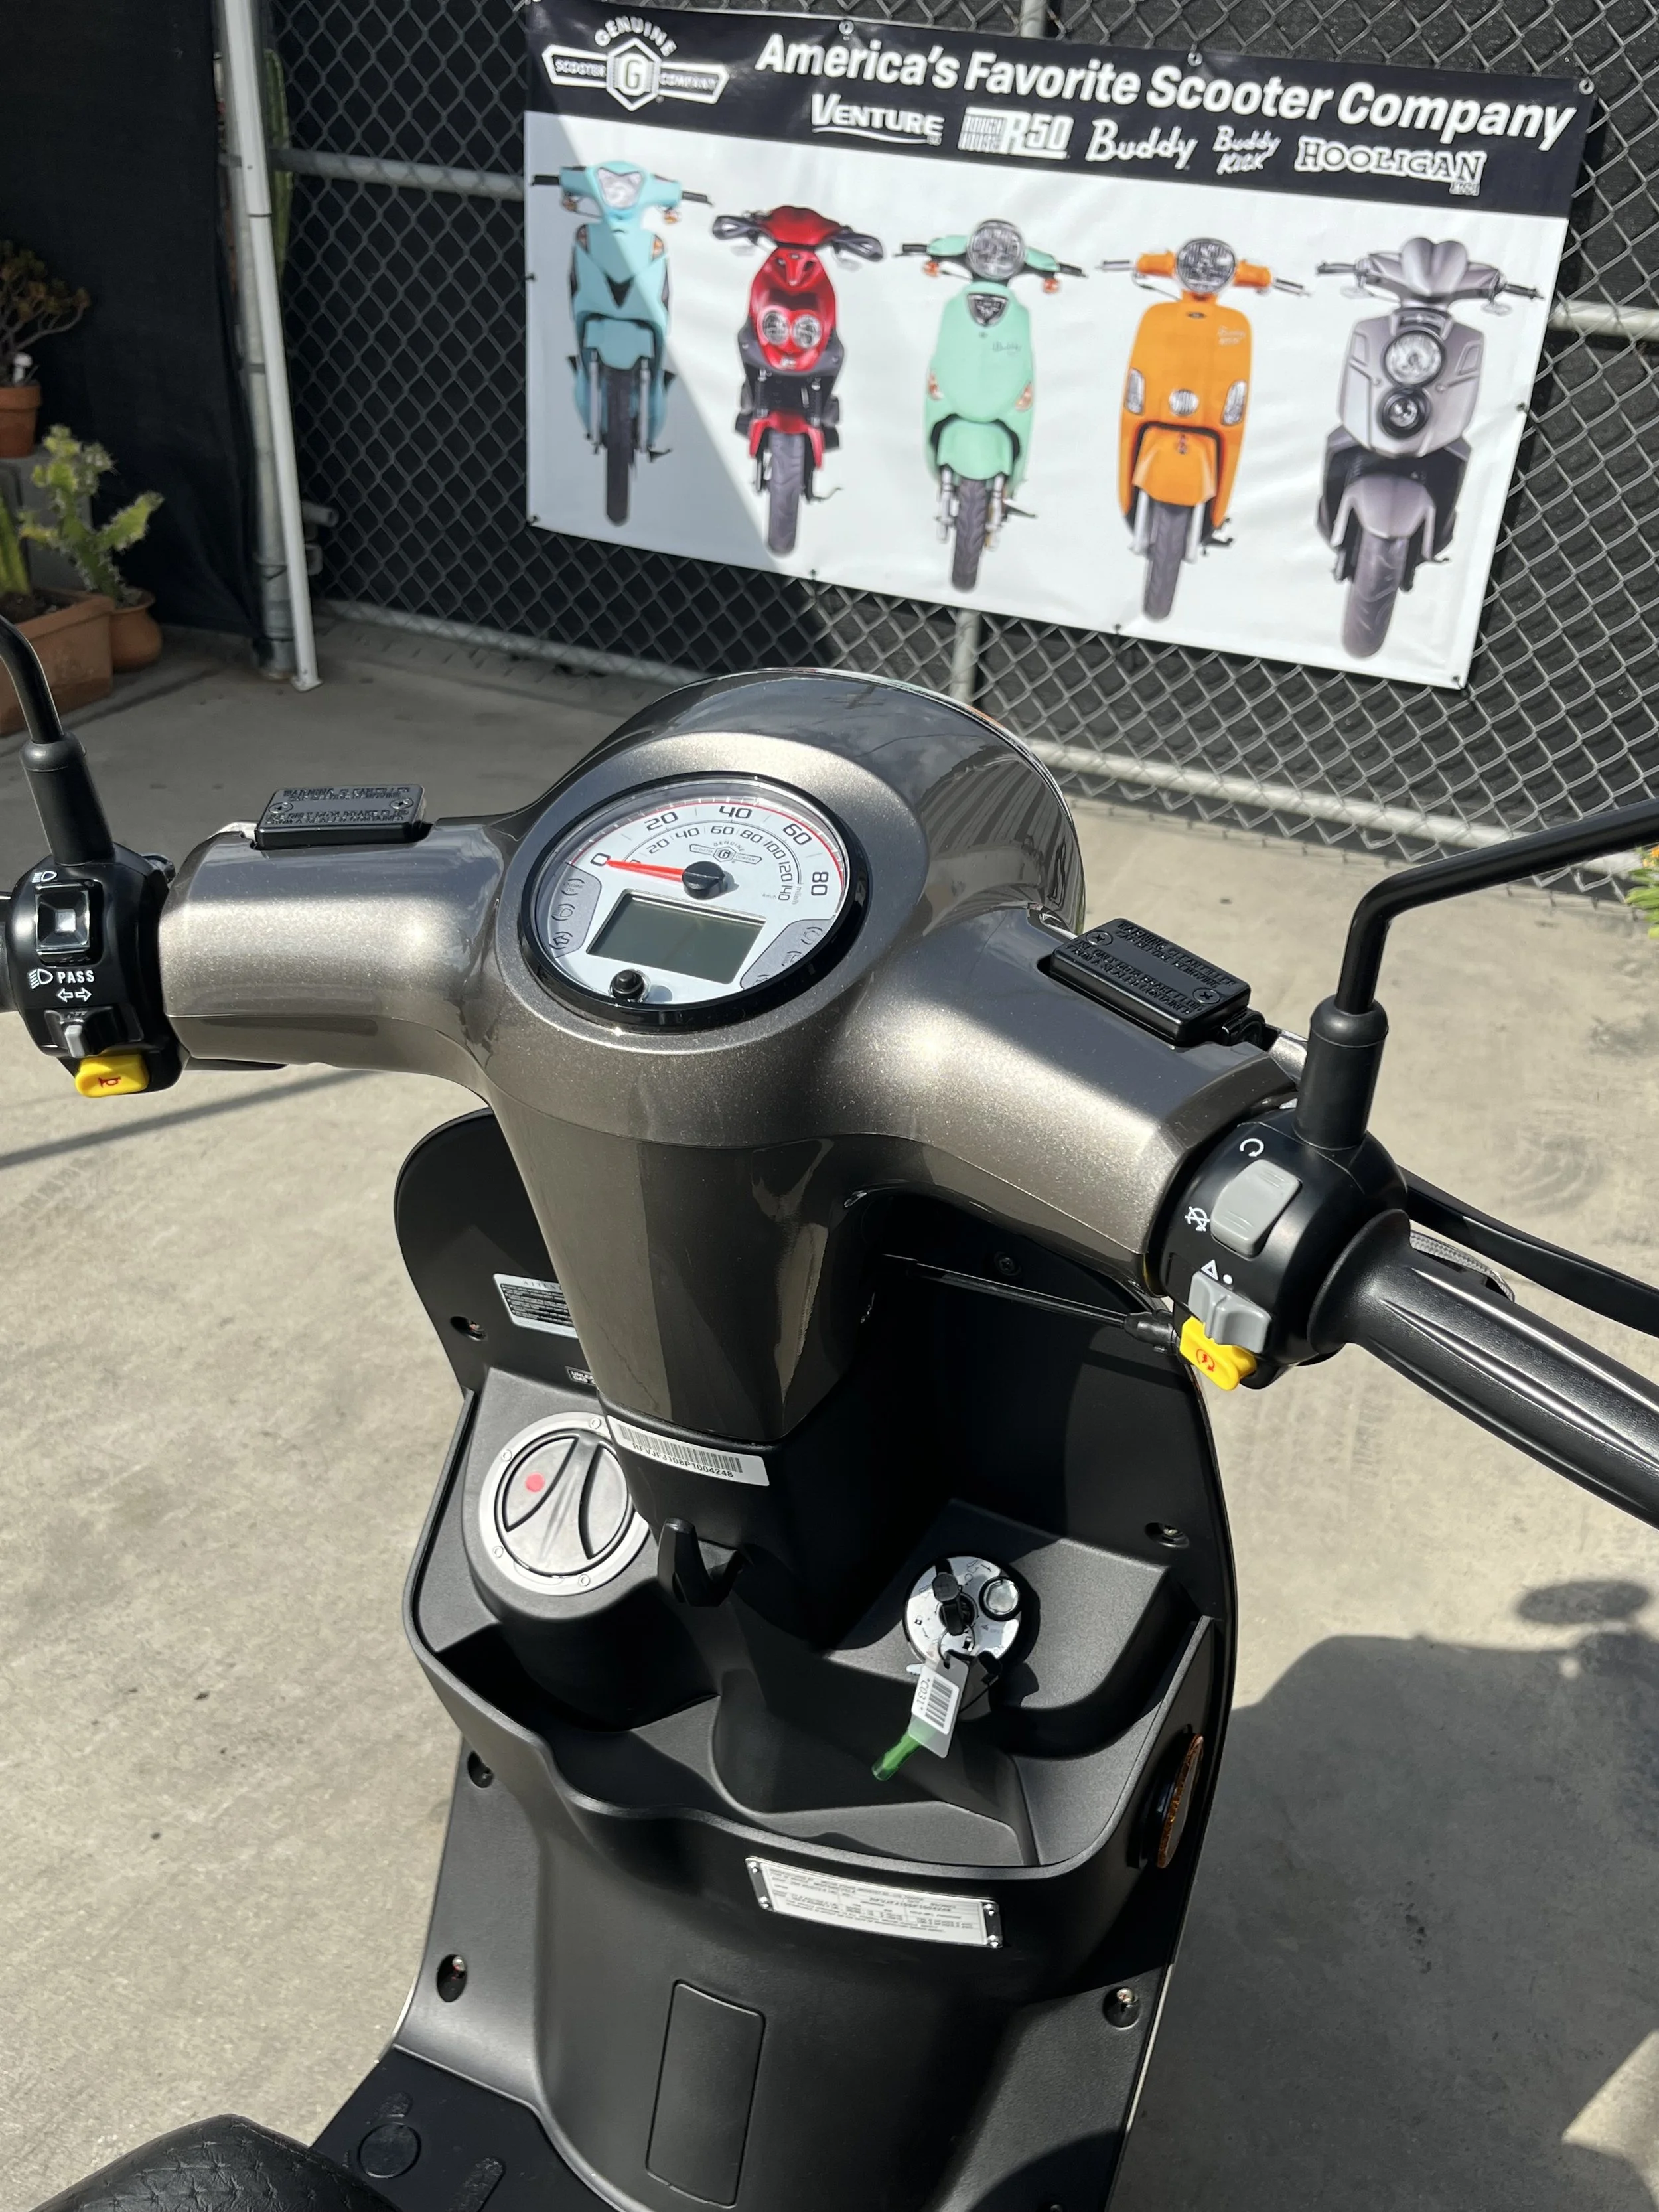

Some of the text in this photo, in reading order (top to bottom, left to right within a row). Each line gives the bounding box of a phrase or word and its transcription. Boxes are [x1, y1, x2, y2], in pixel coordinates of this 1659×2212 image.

[594, 15, 678, 57] GENUINE
[755, 33, 1578, 152] America's Favorite Scooter Company
[1084, 118, 1199, 170] Buddy
[1212, 125, 1282, 163] Buddy
[1295, 137, 1486, 183] HOOLIGAN
[644, 811, 679, 832] 20
[719, 806, 753, 819] 40
[676, 827, 700, 839] 40
[711, 826, 735, 835] 60
[739, 829, 764, 844] 80
[782, 823, 813, 846] 60
[646, 838, 670, 855] 20
[763, 840, 786, 860] 100
[590, 853, 611, 867] 0
[778, 861, 793, 883] 120
[778, 885, 793, 901] 140
[810, 871, 829, 896] 80
[57, 970, 95, 984] PASS
